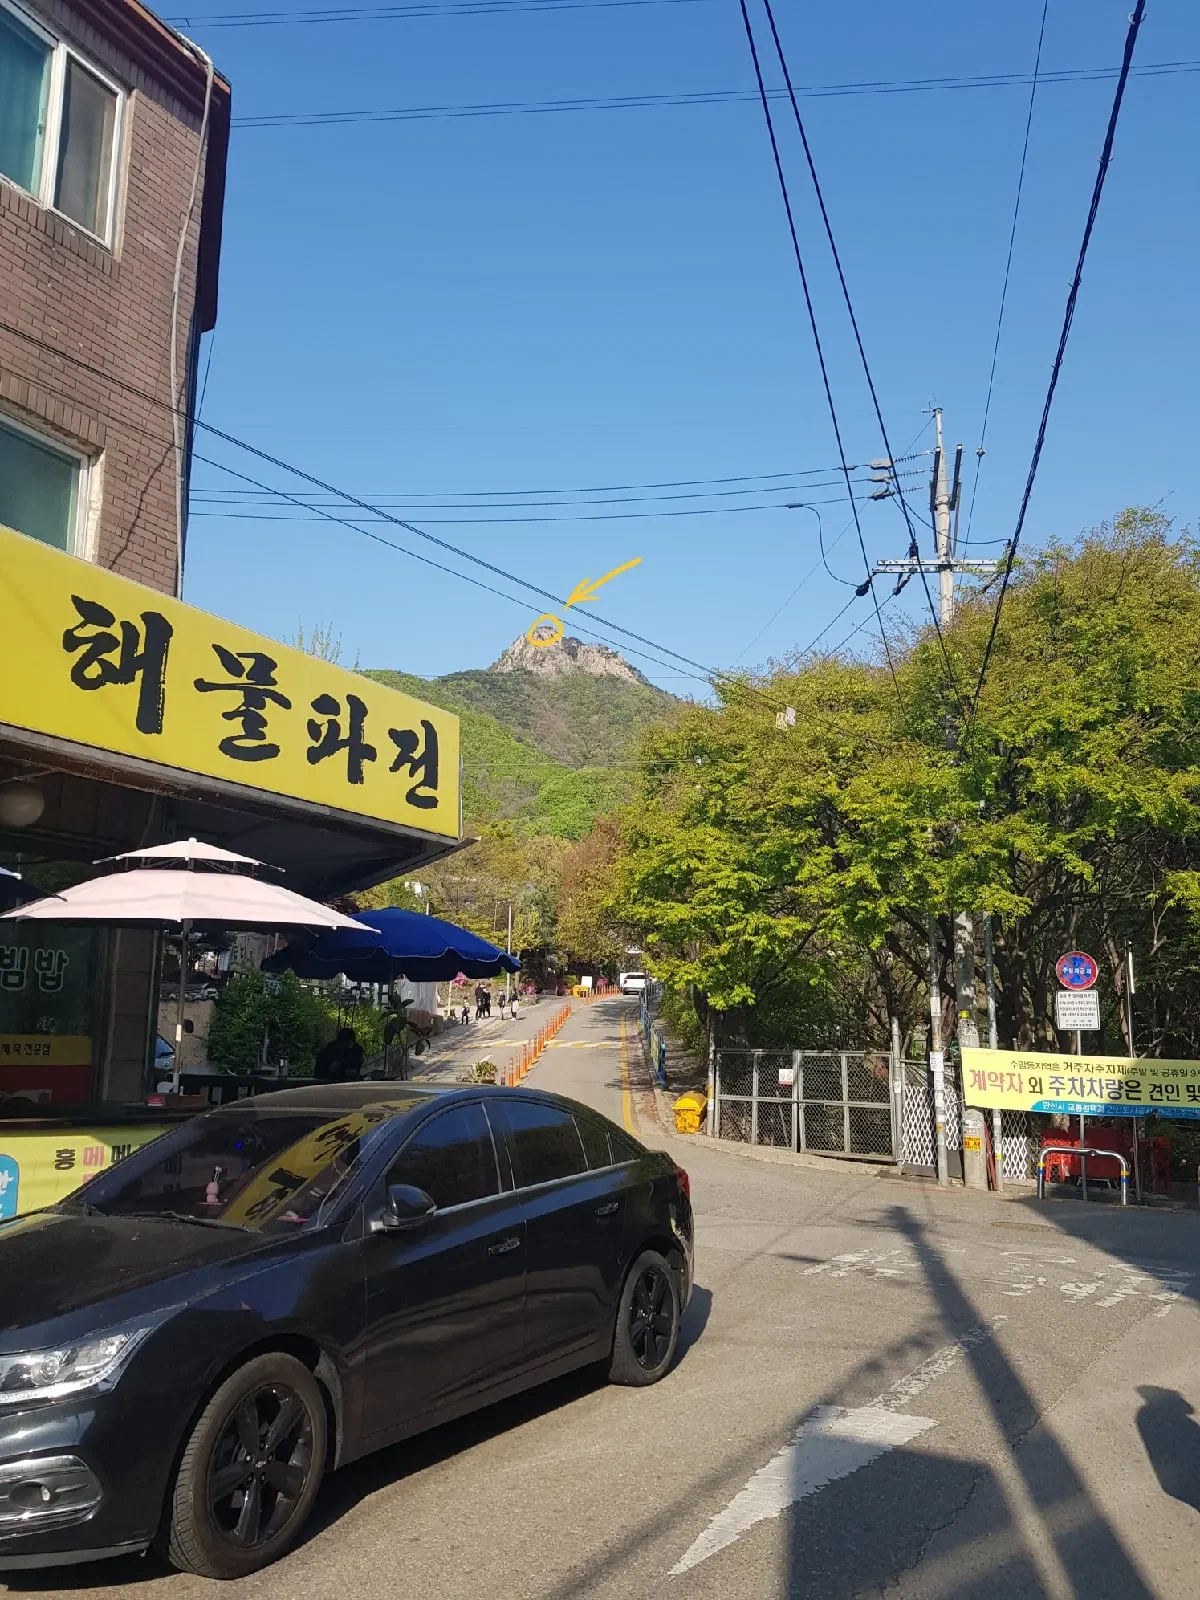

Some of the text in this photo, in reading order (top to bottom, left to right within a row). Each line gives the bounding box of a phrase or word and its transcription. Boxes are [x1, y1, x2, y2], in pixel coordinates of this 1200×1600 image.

[62, 593, 439, 809] 해물파전
[969, 1069, 1023, 1094] 계약자
[1028, 1076, 1043, 1095] 외
[1048, 1075, 1142, 1102] 주차차량은
[1148, 1083, 1180, 1102] 견인
